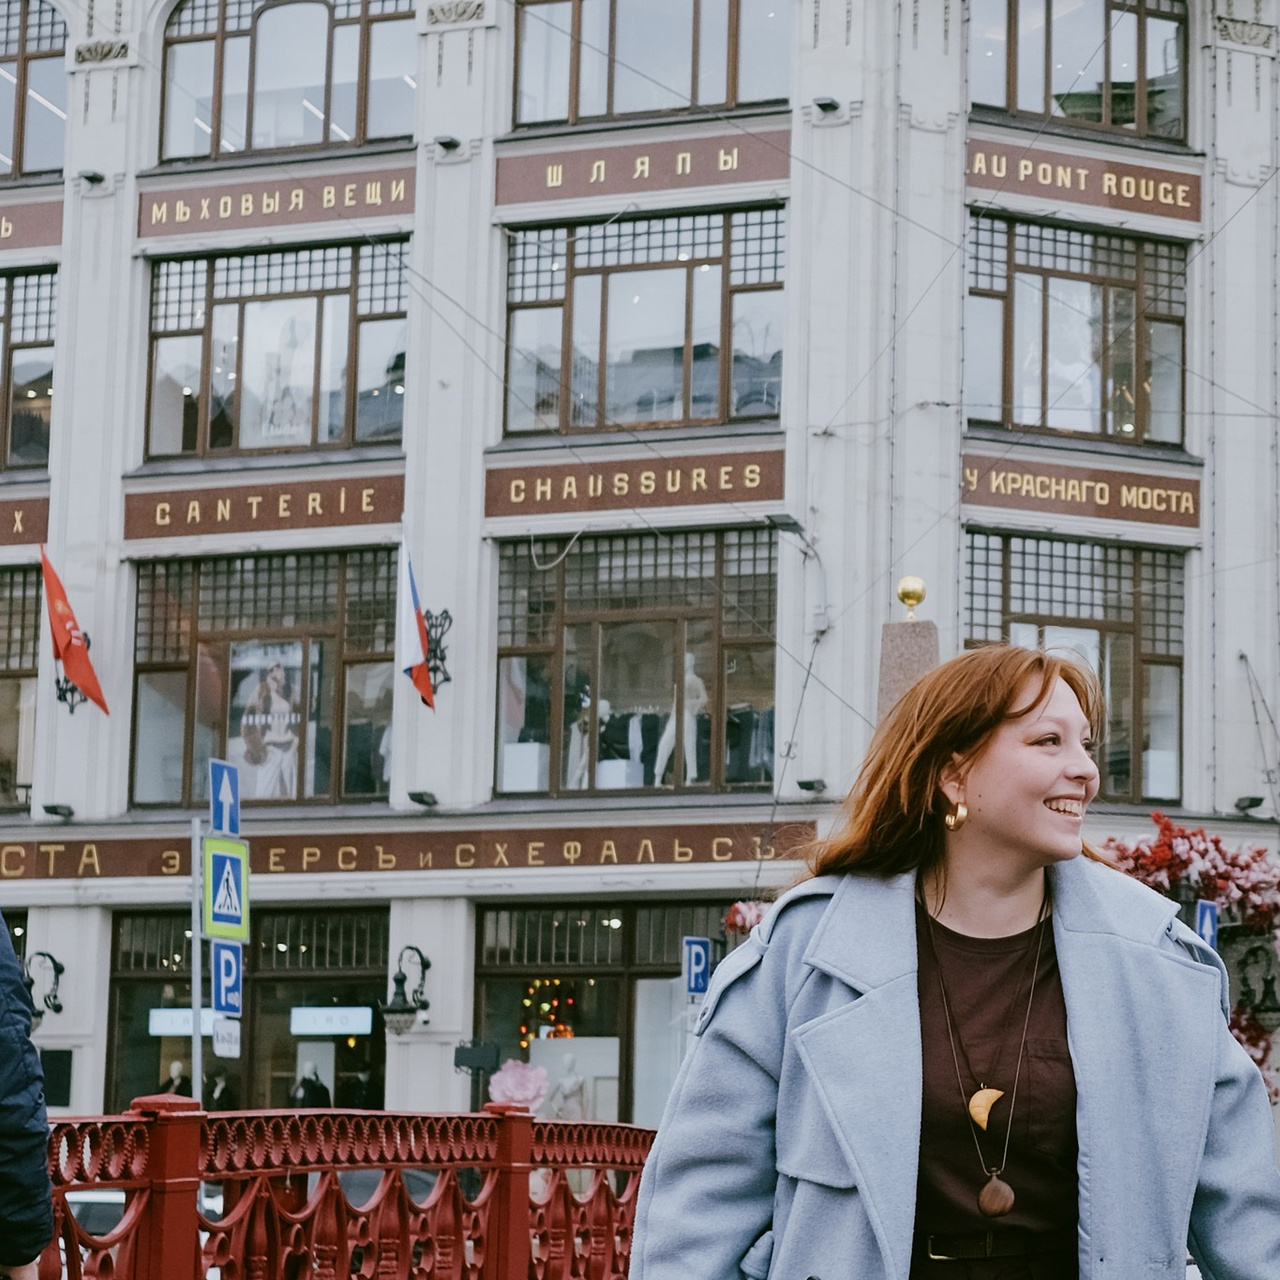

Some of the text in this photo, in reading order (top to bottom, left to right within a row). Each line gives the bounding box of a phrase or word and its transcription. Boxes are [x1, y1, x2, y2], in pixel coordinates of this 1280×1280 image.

[546, 148, 738, 188] ШЛЯПЫ
[972, 152, 1191, 207] AU PONT ROUGE
[322, 179, 405, 209] ВЕЩИ
[510, 464, 761, 503] CHAUSSURES
[966, 467, 1195, 514] У КРАСНАГО МОСТА
[1, 843, 100, 877] СТА
[162, 846, 396, 874] ЭЕРСЪ
[455, 835, 775, 867] СХЕФАЛЬСЪ
